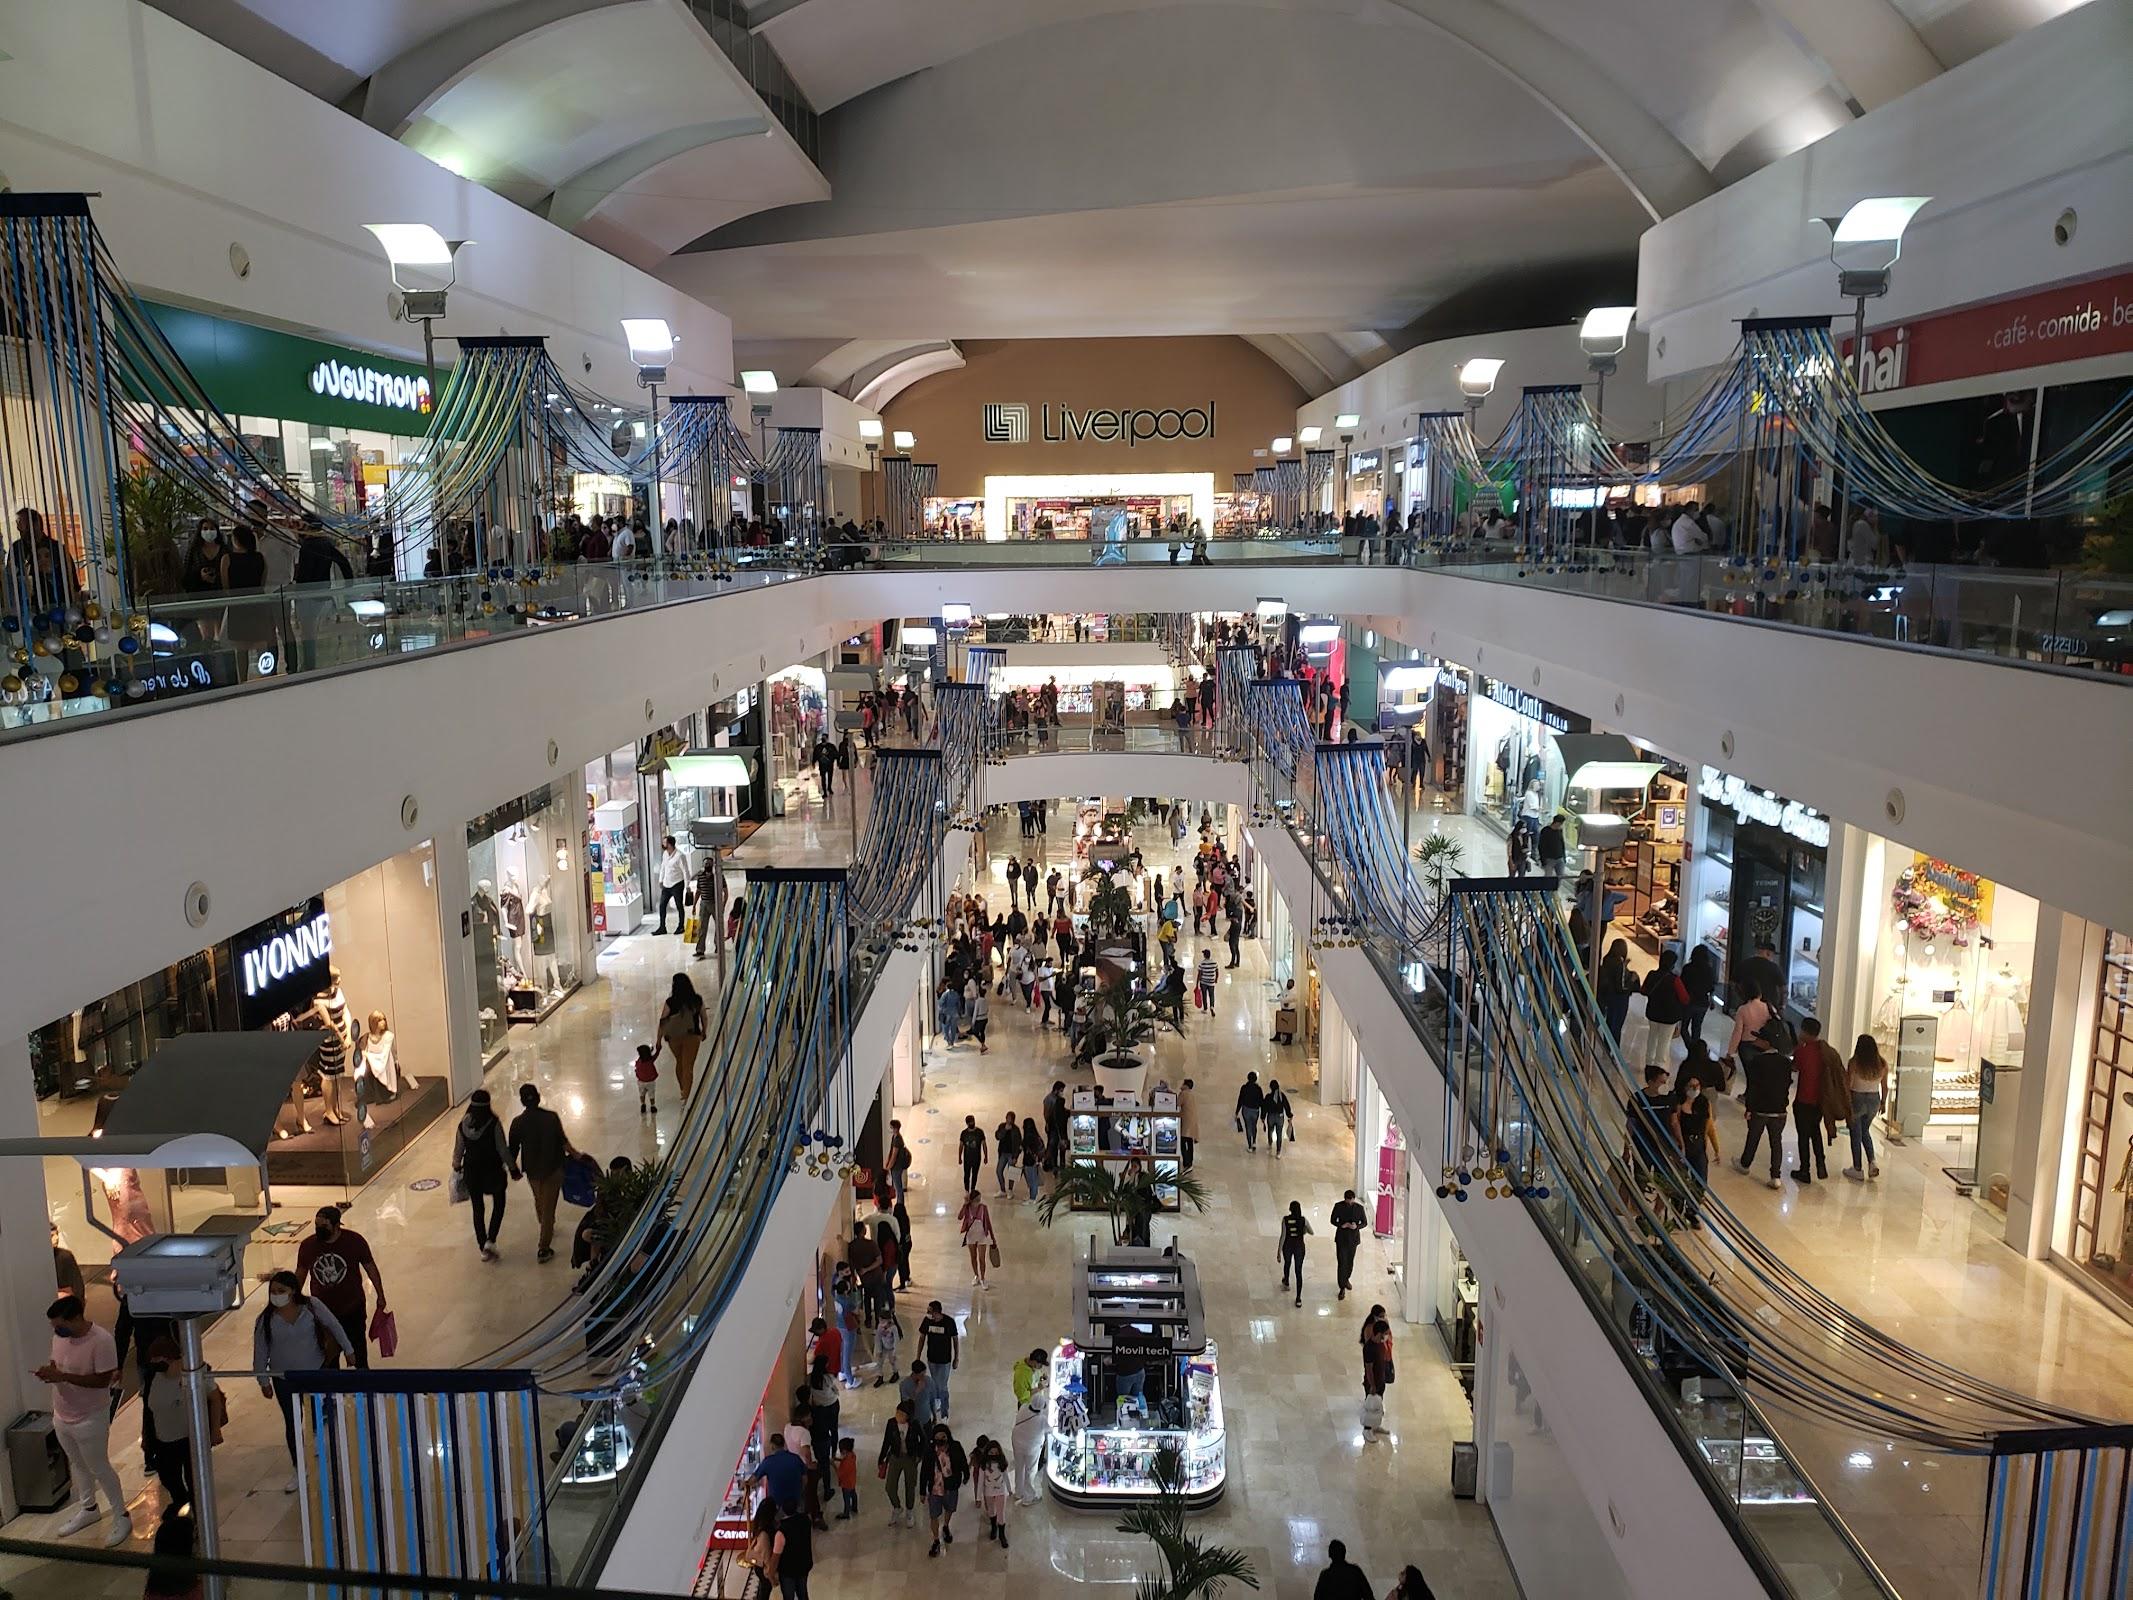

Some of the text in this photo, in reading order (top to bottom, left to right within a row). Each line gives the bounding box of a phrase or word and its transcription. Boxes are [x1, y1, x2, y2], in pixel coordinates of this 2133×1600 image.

[1993, 314, 2028, 349] café
[2037, 301, 2101, 340] comida
[312, 358, 417, 412] JUGUETRON
[1042, 400, 1216, 447] Liverpool
[1492, 679, 1568, 732] Aldo Conti ITALIA
[243, 912, 333, 996] IVONNE
[1115, 1345, 1170, 1356] Movil tech
